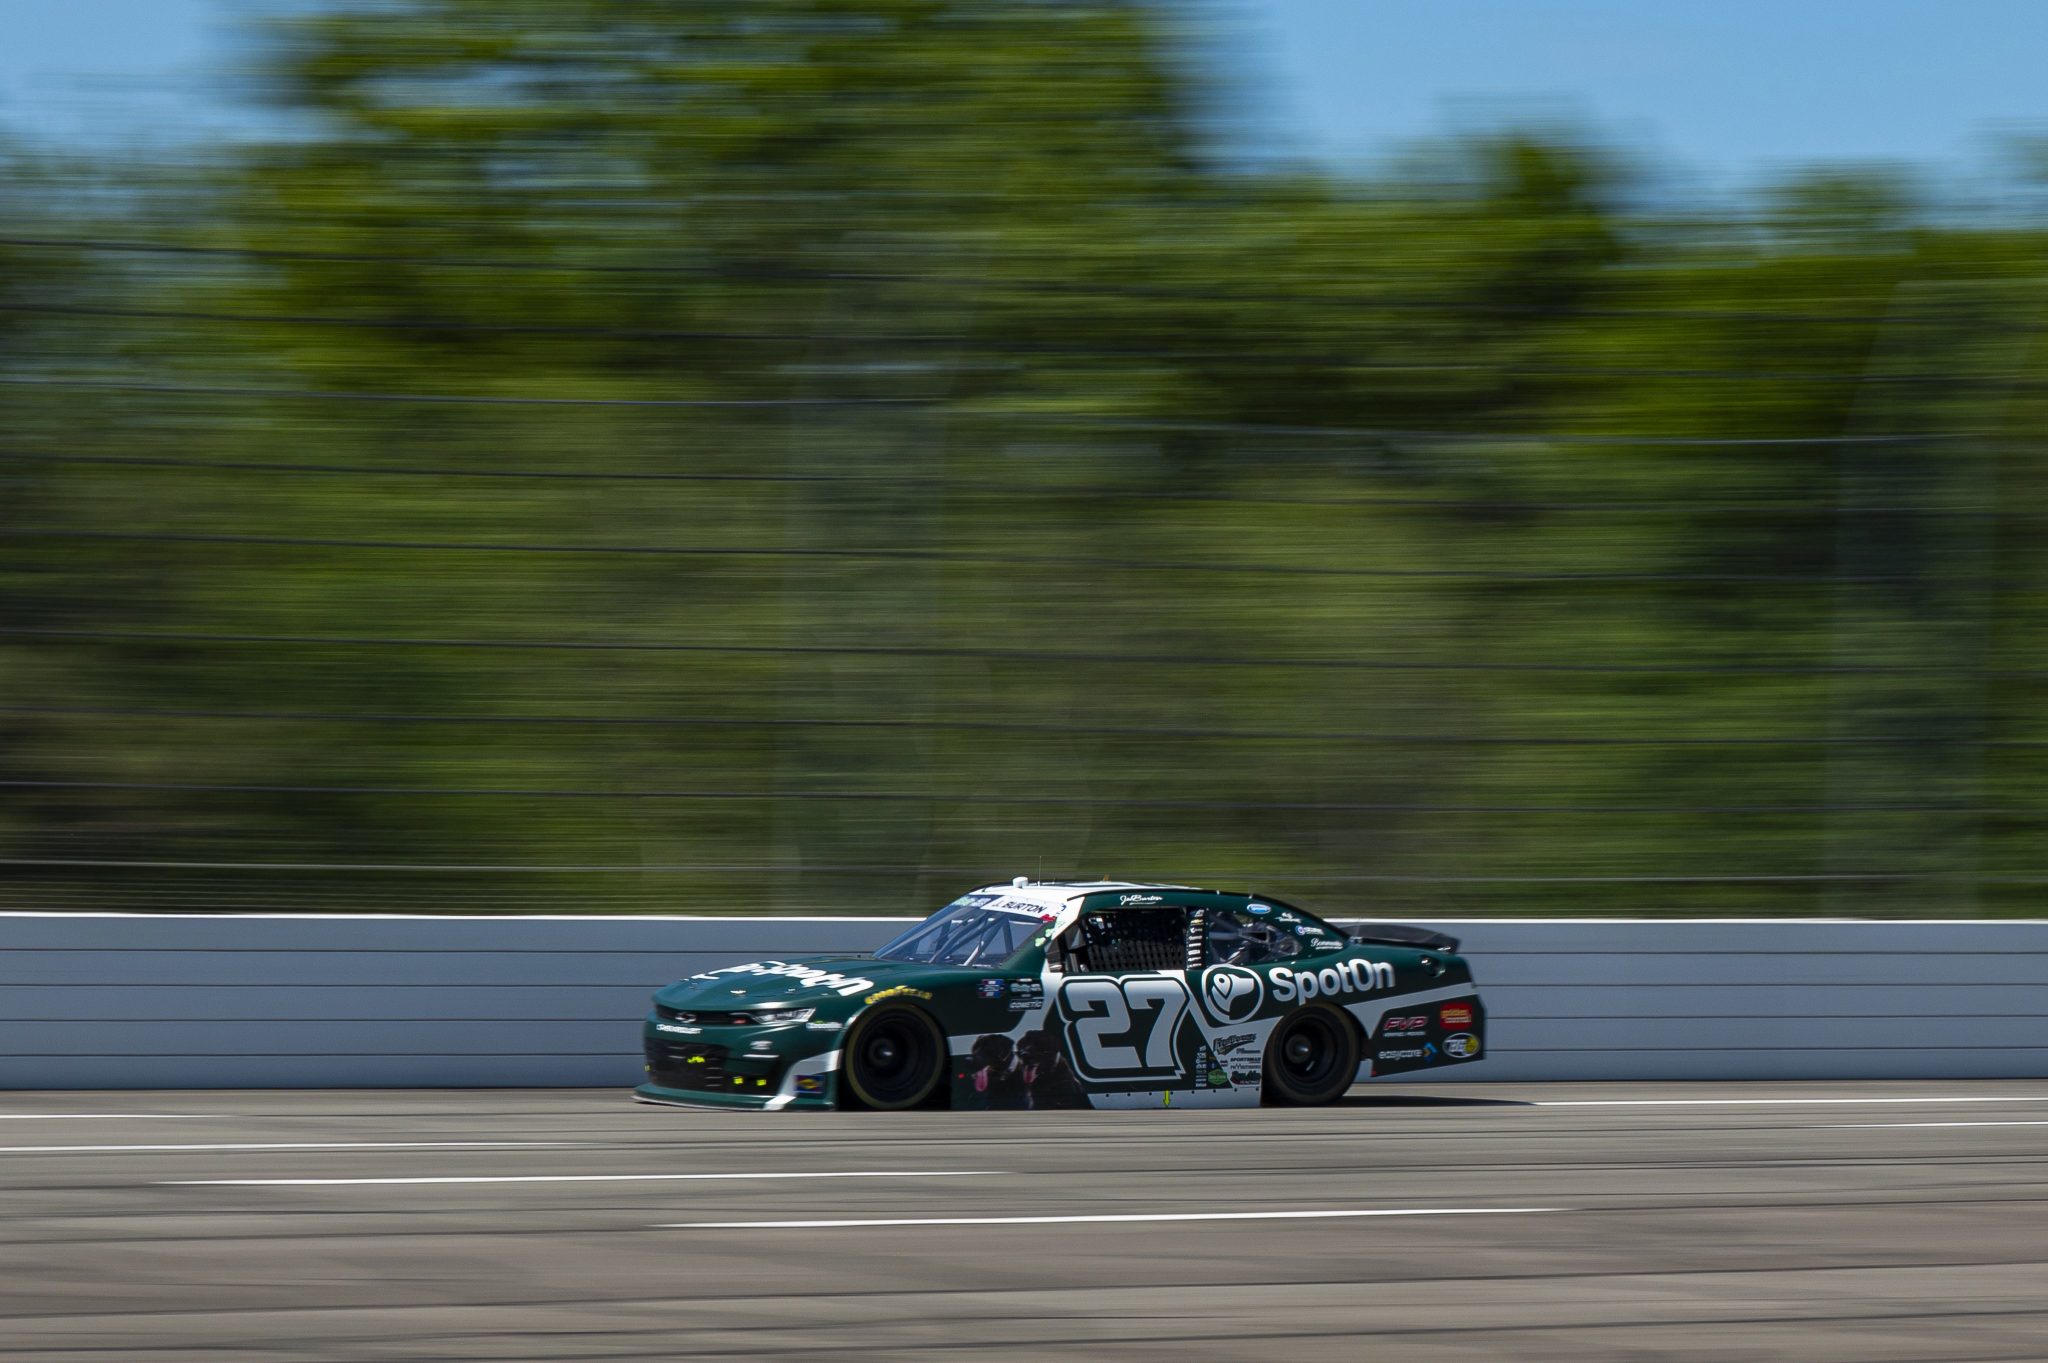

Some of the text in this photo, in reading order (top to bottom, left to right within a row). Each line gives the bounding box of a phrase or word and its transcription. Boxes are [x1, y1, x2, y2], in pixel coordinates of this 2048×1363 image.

[1005, 901, 1048, 914] BURTON
[1268, 958, 1395, 1005] SpotOn
[1062, 979, 1188, 1076] 27
